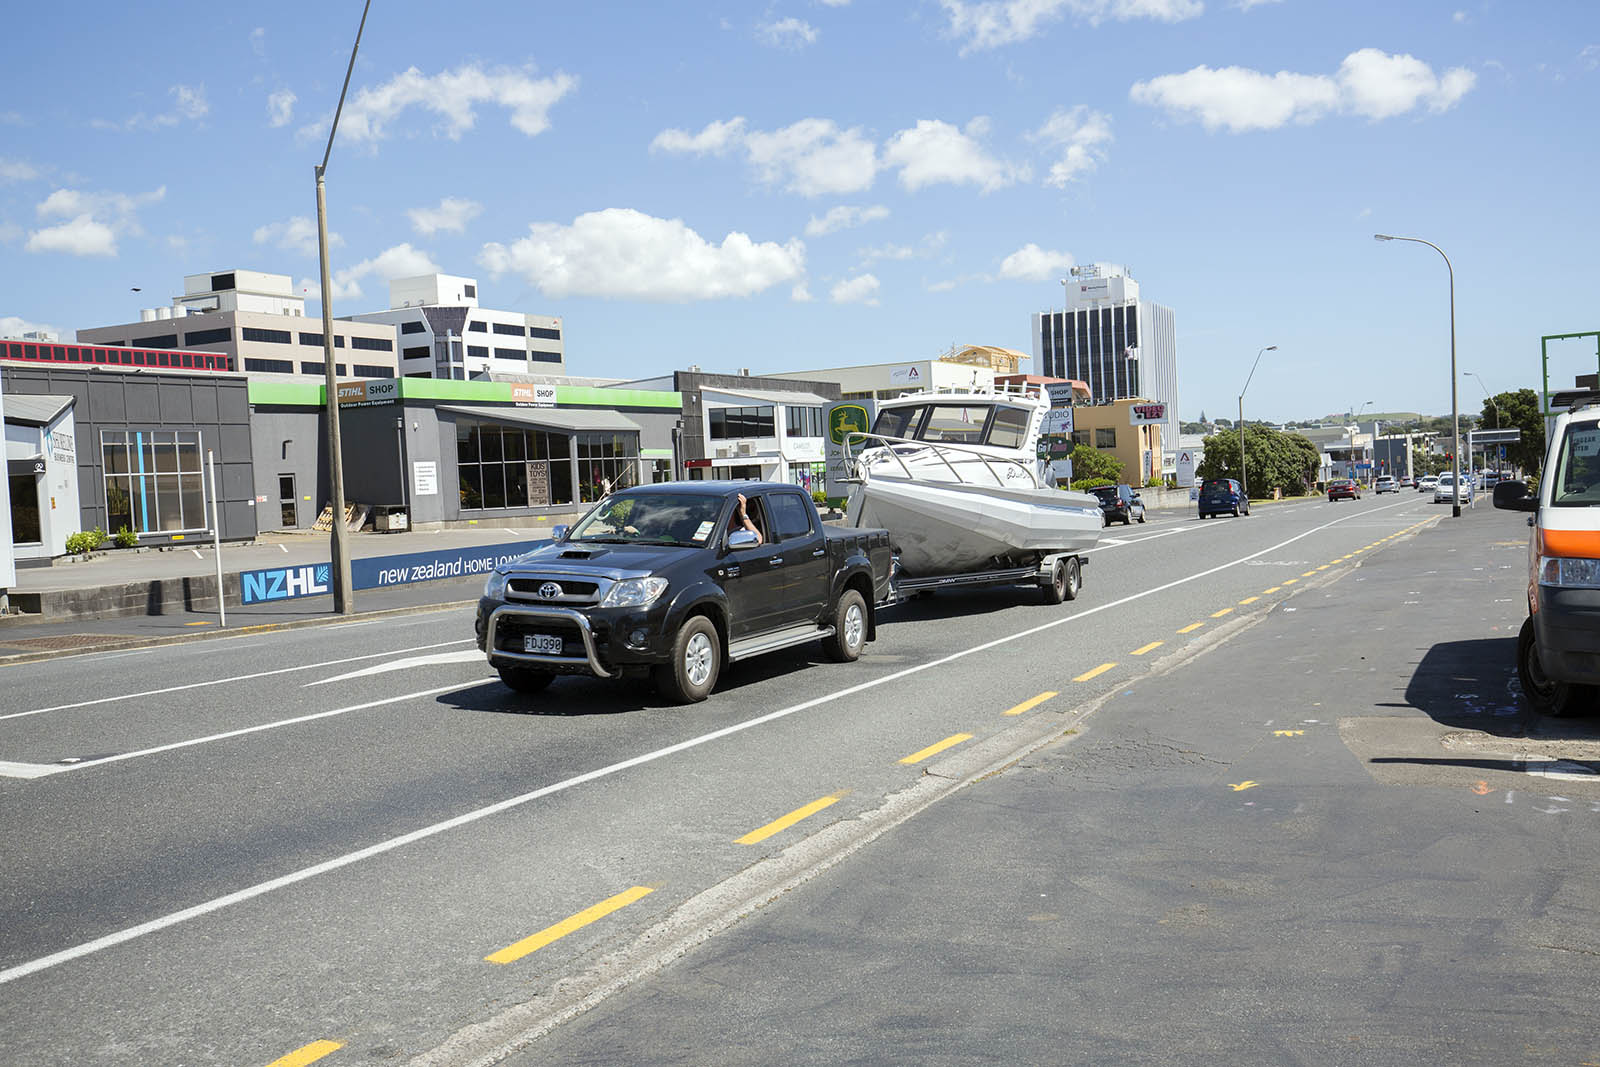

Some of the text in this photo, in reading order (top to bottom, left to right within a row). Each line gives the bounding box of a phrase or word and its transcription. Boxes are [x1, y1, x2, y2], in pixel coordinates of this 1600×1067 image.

[338, 384, 394, 398] STIHL SHOP
[513, 388, 554, 398] STIHL SHOP
[1134, 405, 1165, 413] VIDEO
[1145, 411, 1163, 419] EZY
[378, 566, 409, 585] new
[411, 557, 462, 581] zealand
[463, 557, 493, 573] HOME
[243, 567, 328, 602] NZHL
